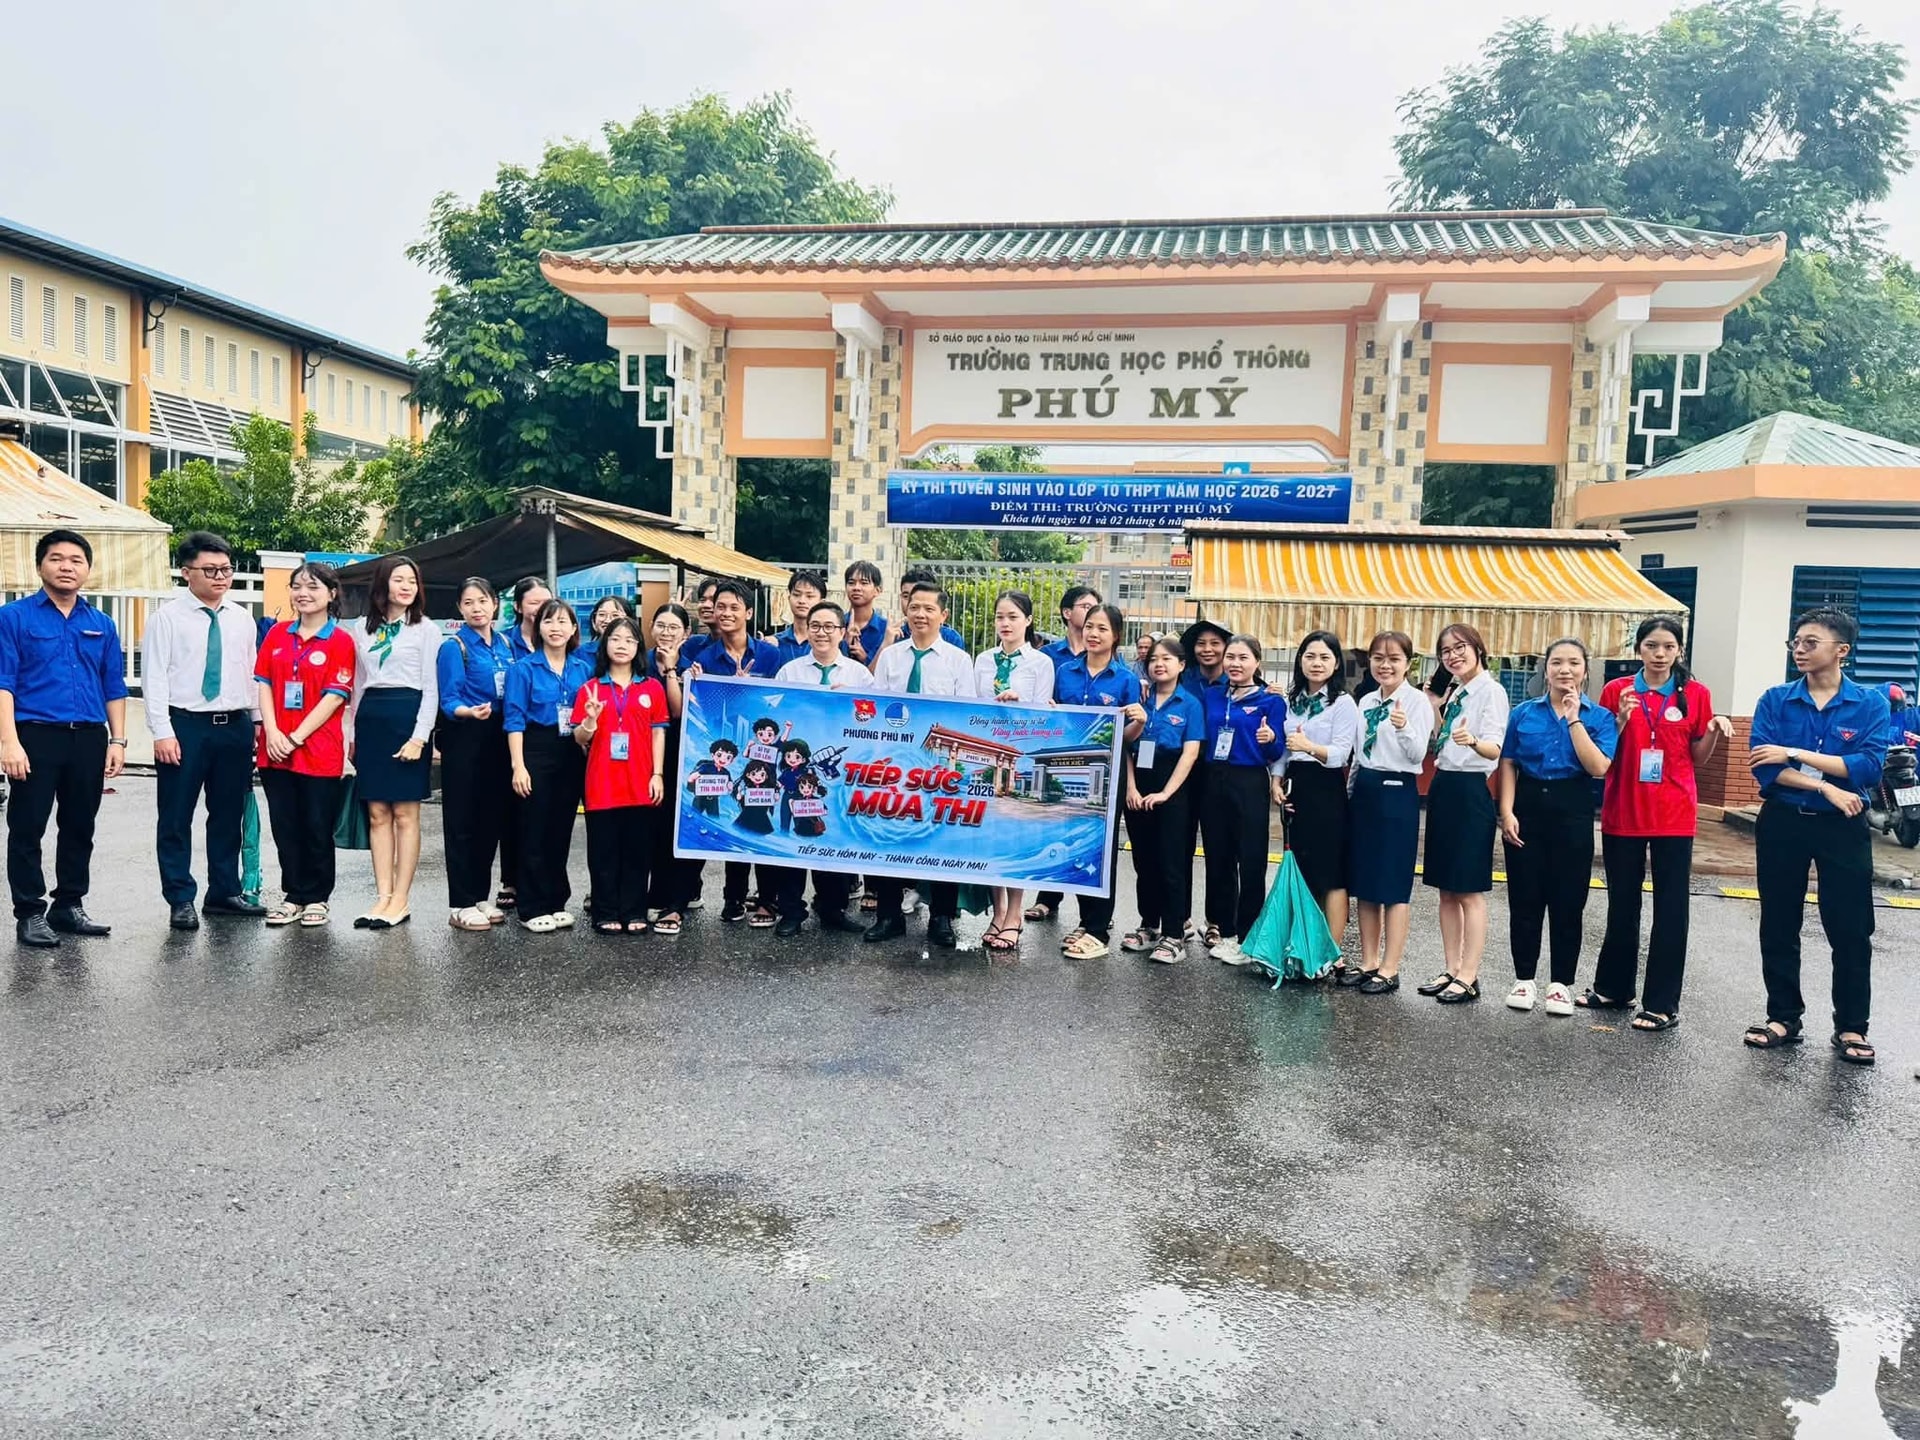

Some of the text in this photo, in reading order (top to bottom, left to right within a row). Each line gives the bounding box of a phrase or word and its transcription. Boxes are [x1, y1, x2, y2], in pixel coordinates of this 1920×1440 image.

[967, 334, 983, 344] DỤC
[1015, 334, 1030, 345] TẠO
[1062, 331, 1080, 342] PHỐ
[1096, 331, 1112, 342] CHÍ
[1114, 334, 1135, 342] MINH
[947, 339, 1311, 375] TRƯỜNG TRUNG HỌC PHỔ THÔNG
[997, 374, 1249, 419] PHÚ MỸ
[922, 481, 945, 494] THI
[997, 482, 1031, 496] SINH
[1036, 480, 1064, 496] VÀO
[1069, 481, 1097, 497] LỚP
[1102, 483, 1119, 497] 10
[1123, 484, 1162, 498] THPT
[1166, 482, 1199, 498] NĂM
[1204, 485, 1236, 500] HỌC
[1240, 484, 1280, 498] 2026
[1296, 485, 1336, 498] 2027
[1031, 502, 1062, 512] THI:
[1065, 502, 1128, 513] TRƯỜNG
[1131, 504, 1172, 513] THPT
[1175, 502, 1205, 514] PHÚ
[1209, 502, 1234, 514] MỸ
[1001, 514, 1029, 523] Khóa
[1031, 515, 1046, 524] thi
[1048, 515, 1077, 526] ngày:
[1079, 515, 1091, 524] 01
[1095, 515, 1107, 525] và
[1110, 516, 1122, 525] 02
[1125, 515, 1155, 527] tháng
[1158, 516, 1166, 525] 6
[901, 732, 915, 744] MỸ
[844, 757, 964, 795] TIẾP SỨC
[967, 784, 995, 797] 2026
[847, 784, 988, 827] MÙA THI
[797, 844, 817, 855] TIẾP
[817, 846, 836, 857] SỨC
[836, 848, 858, 859] HÔM
[858, 852, 877, 861] NAY
[885, 853, 915, 864] THÀNH
[915, 855, 940, 866] CÔNG
[941, 858, 966, 868] NGÀY
[966, 861, 988, 871] MAI!
